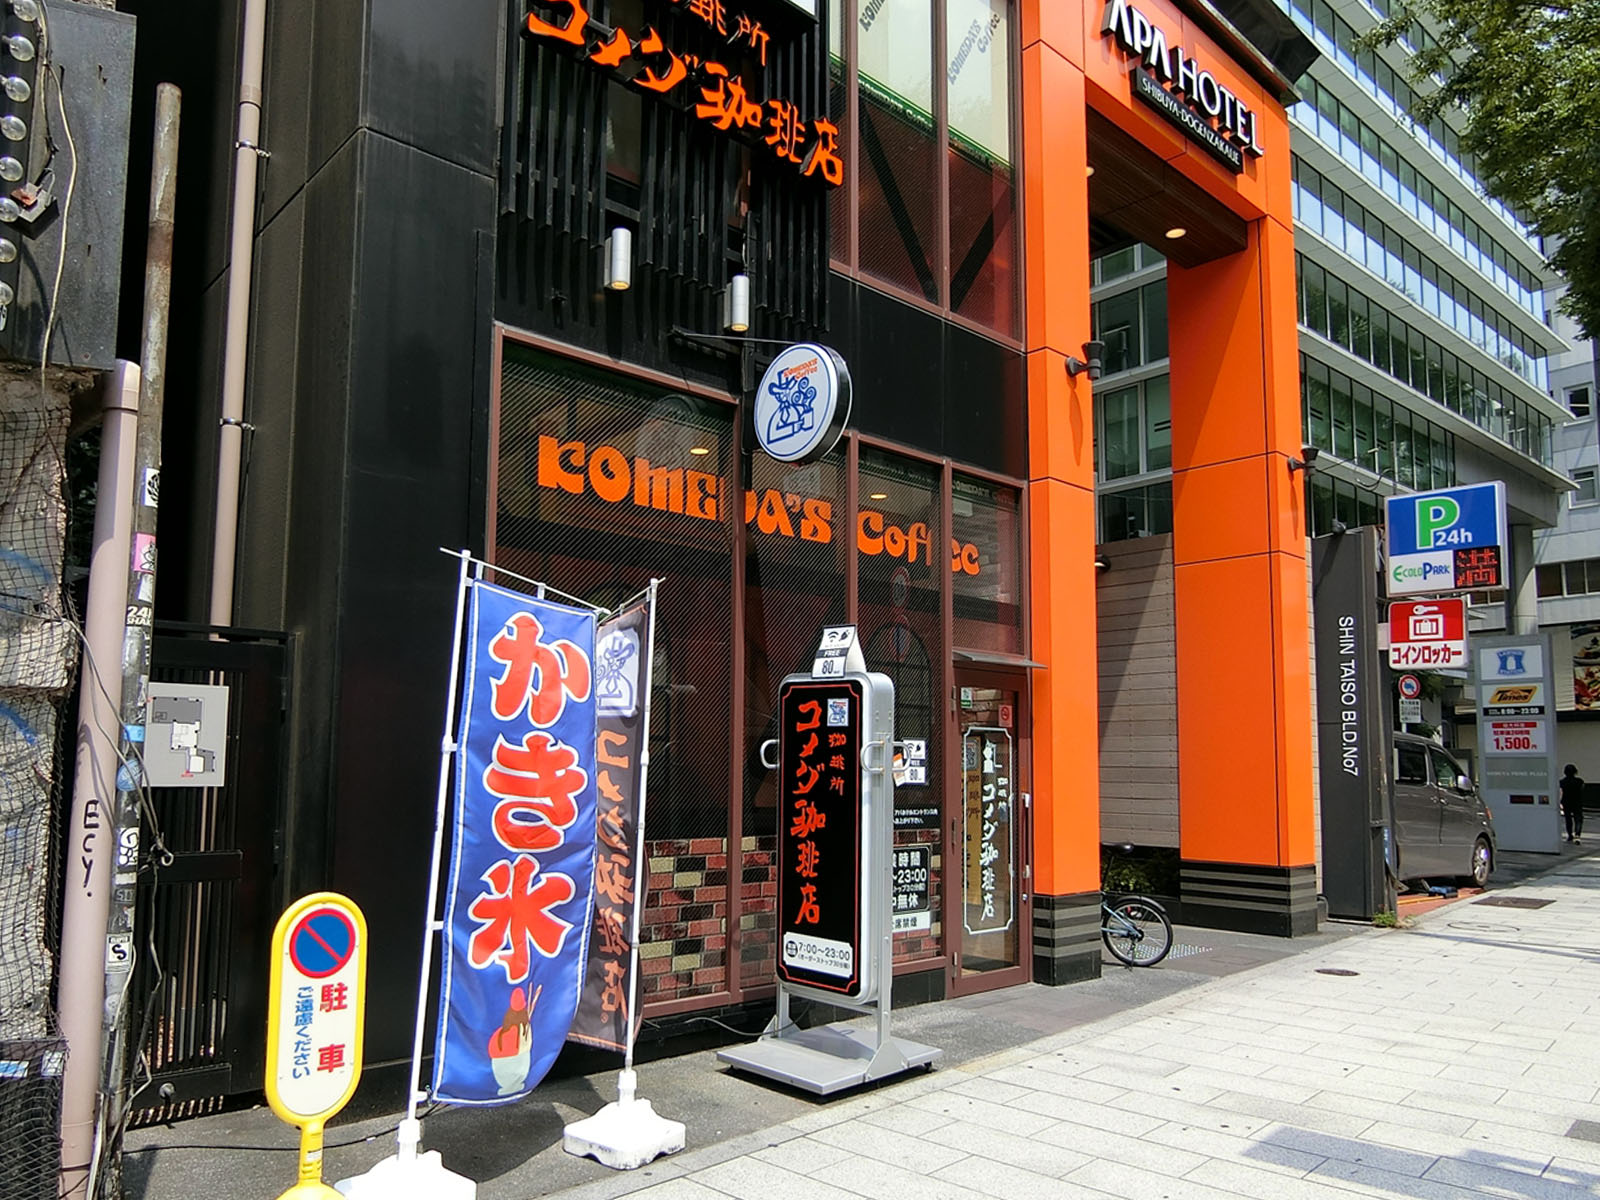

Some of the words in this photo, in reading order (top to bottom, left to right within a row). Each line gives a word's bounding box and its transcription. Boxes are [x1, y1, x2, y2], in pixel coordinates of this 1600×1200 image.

[1109, 0, 1173, 80] APA
[1177, 47, 1265, 156] HOTEL
[1416, 496, 1460, 550] P
[1435, 528, 1473, 546] 24h
[1338, 616, 1355, 655] SHIN
[1392, 644, 1463, 665] コインロッカー
[1340, 659, 1357, 706] TAISO
[468, 611, 593, 985] かき氷
[790, 700, 826, 925] コメダ珈琲店
[292, 985, 314, 1080] ご遠慮ください
[316, 981, 348, 1073] 駐車
